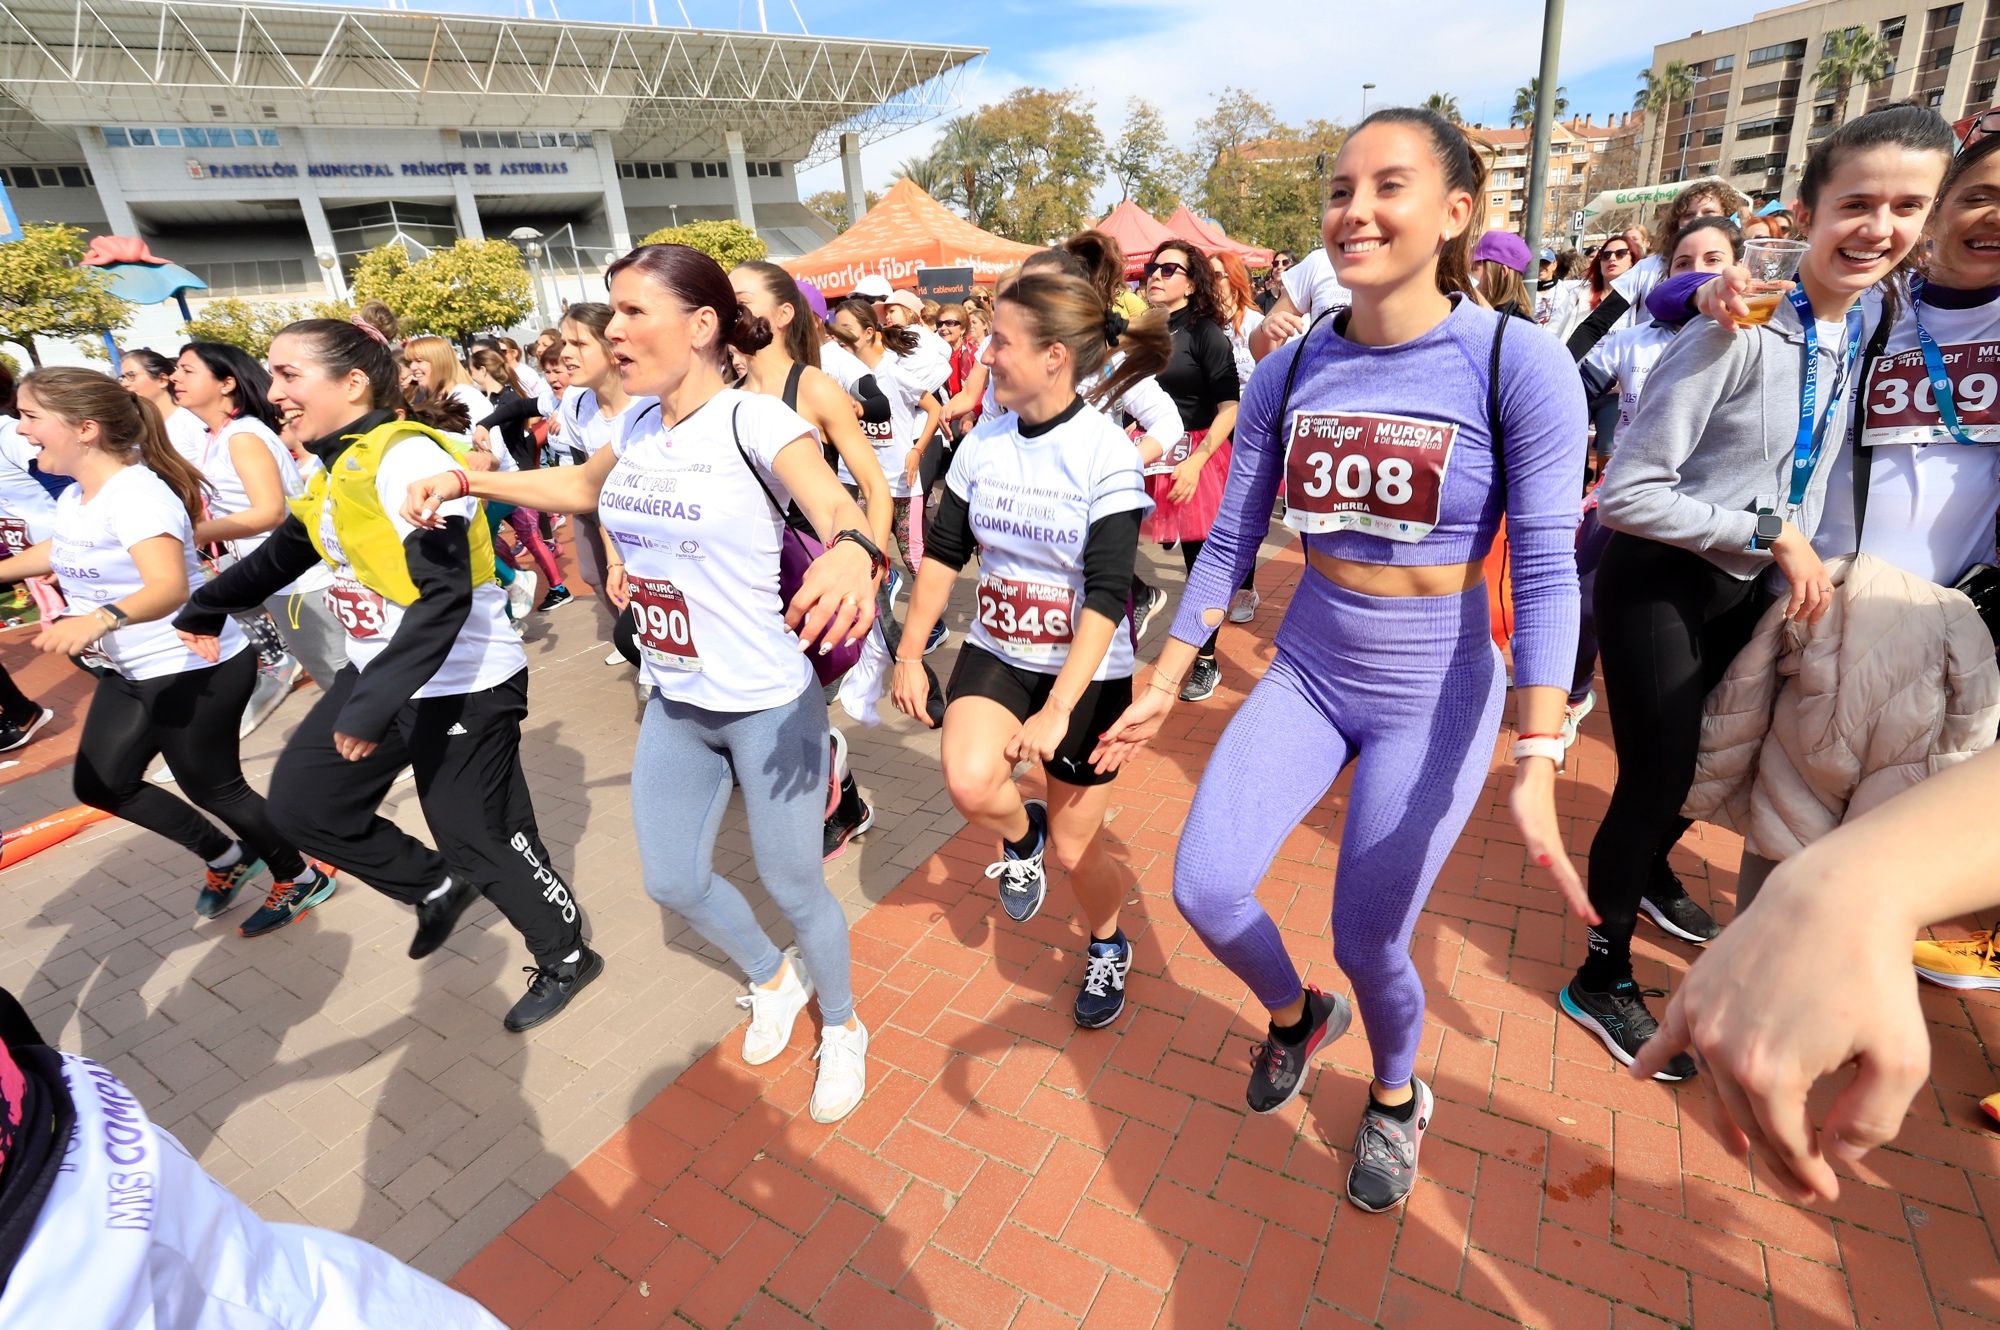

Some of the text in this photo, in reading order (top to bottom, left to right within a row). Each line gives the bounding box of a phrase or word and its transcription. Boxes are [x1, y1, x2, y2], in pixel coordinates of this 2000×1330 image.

[209, 161, 568, 177] PABELLÓN MUNICIPAL PRÍNCIPE DE ASTURIAS
[878, 257, 926, 281] fibra
[933, 284, 964, 294] cableworld
[1906, 353, 1963, 367] mer
[1802, 338, 1819, 418] UNIVERSAE
[1871, 373, 1998, 415] 309
[859, 420, 890, 436] 269
[1313, 417, 1339, 426] carrera
[1376, 422, 1443, 443] MURCIA
[1317, 426, 1364, 448] mujer
[1392, 437, 1421, 447] MARZO
[1303, 451, 1413, 505] 308
[601, 490, 701, 522] COMPAÑERAS
[996, 494, 1015, 513] MÍ
[1333, 501, 1370, 512] NEREA
[974, 512, 1079, 544] COMPAÑERAS
[630, 600, 689, 646] 090
[981, 595, 1070, 637] 2346
[510, 831, 577, 924] adidas
[107, 1171, 155, 1231] MIS
